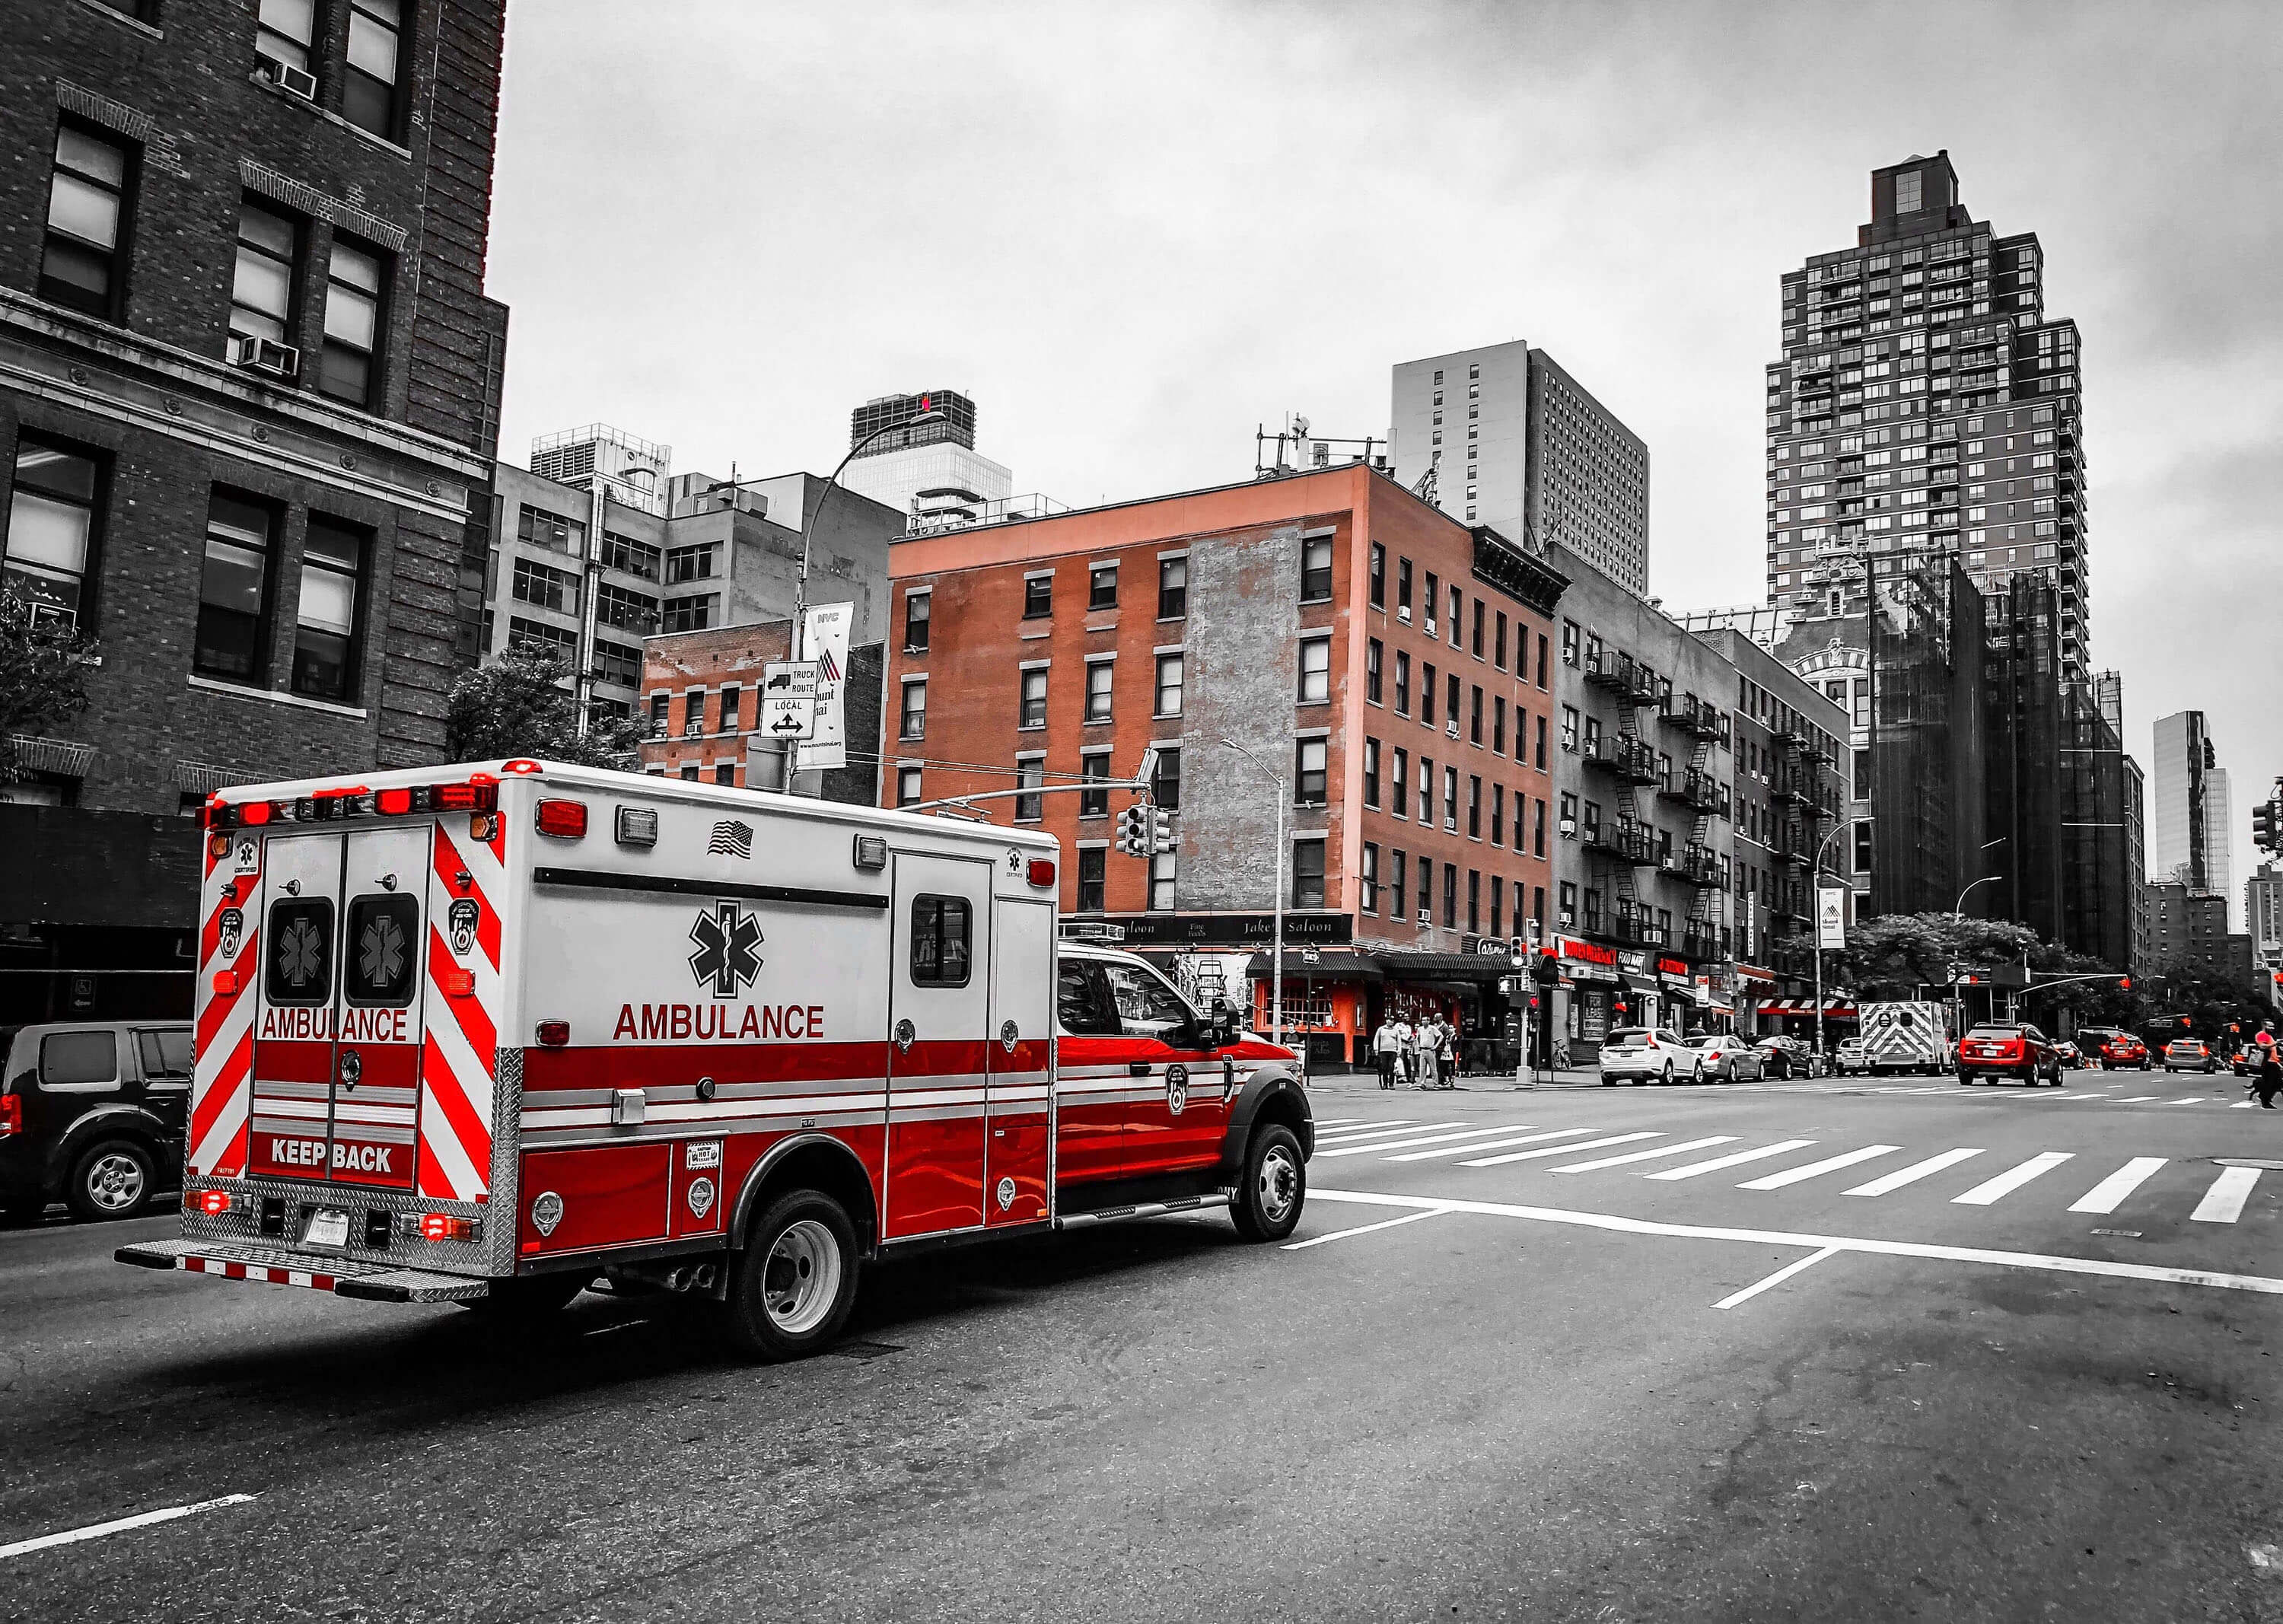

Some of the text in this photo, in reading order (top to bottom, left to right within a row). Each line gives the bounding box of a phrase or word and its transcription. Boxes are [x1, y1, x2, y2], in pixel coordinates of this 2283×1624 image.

[817, 612, 839, 623] NYC
[793, 670, 815, 679] TRUCK
[791, 684, 814, 693] ROUTE
[775, 701, 802, 710] LOCAL
[1127, 920, 1154, 934] loon
[1243, 919, 1332, 935] Jake' Saloon
[1619, 951, 1631, 964] FOOD
[262, 1008, 407, 1041] AMBULANCE
[613, 1003, 824, 1040] AMBULANCE
[272, 1138, 392, 1173] KEEP BACK
